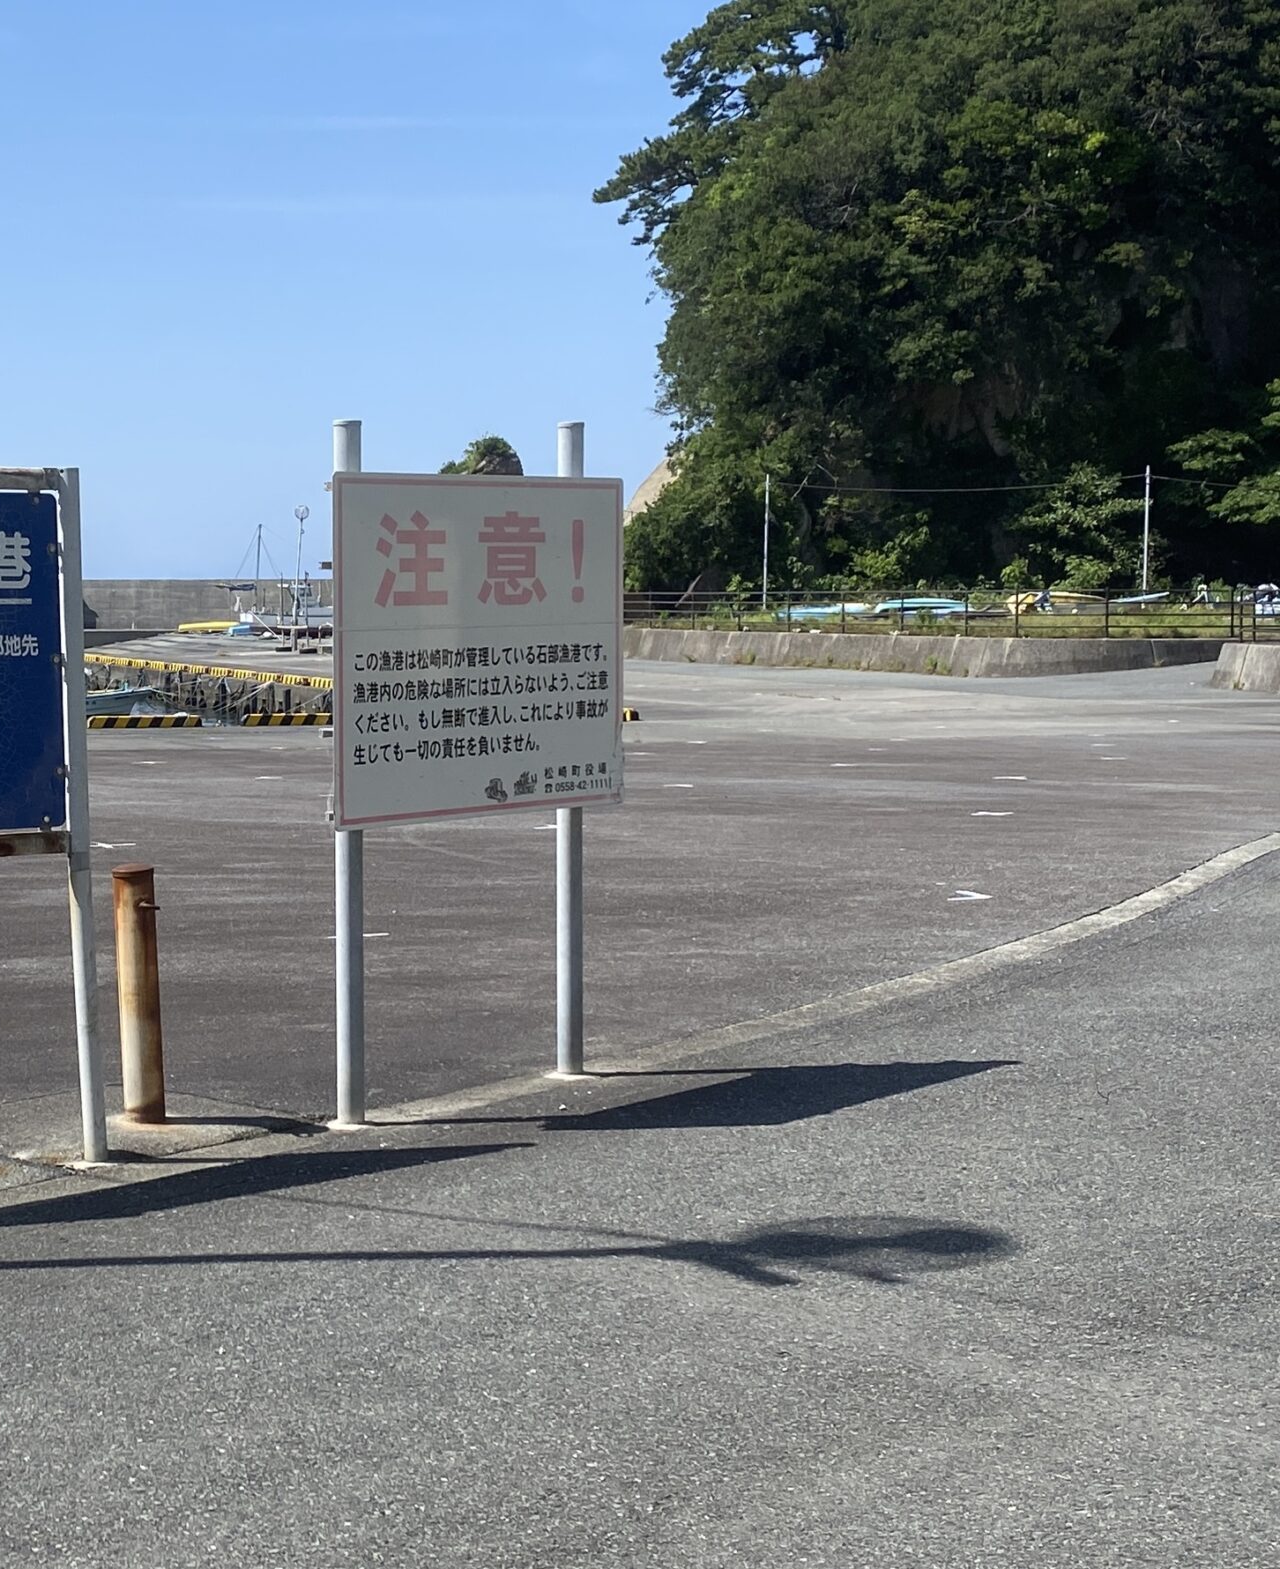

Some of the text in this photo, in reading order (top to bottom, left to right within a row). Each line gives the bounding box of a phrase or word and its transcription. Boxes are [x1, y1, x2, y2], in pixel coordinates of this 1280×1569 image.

[354, 642, 608, 672] この漁港は松崎町が管理している石部漁港です。
[353, 671, 609, 704] 漁港内の危険な場所には立入らないよう、ご注意
[353, 732, 540, 766] 生じても一切の責任を負いません。
[544, 762, 607, 780] 松崎町役場
